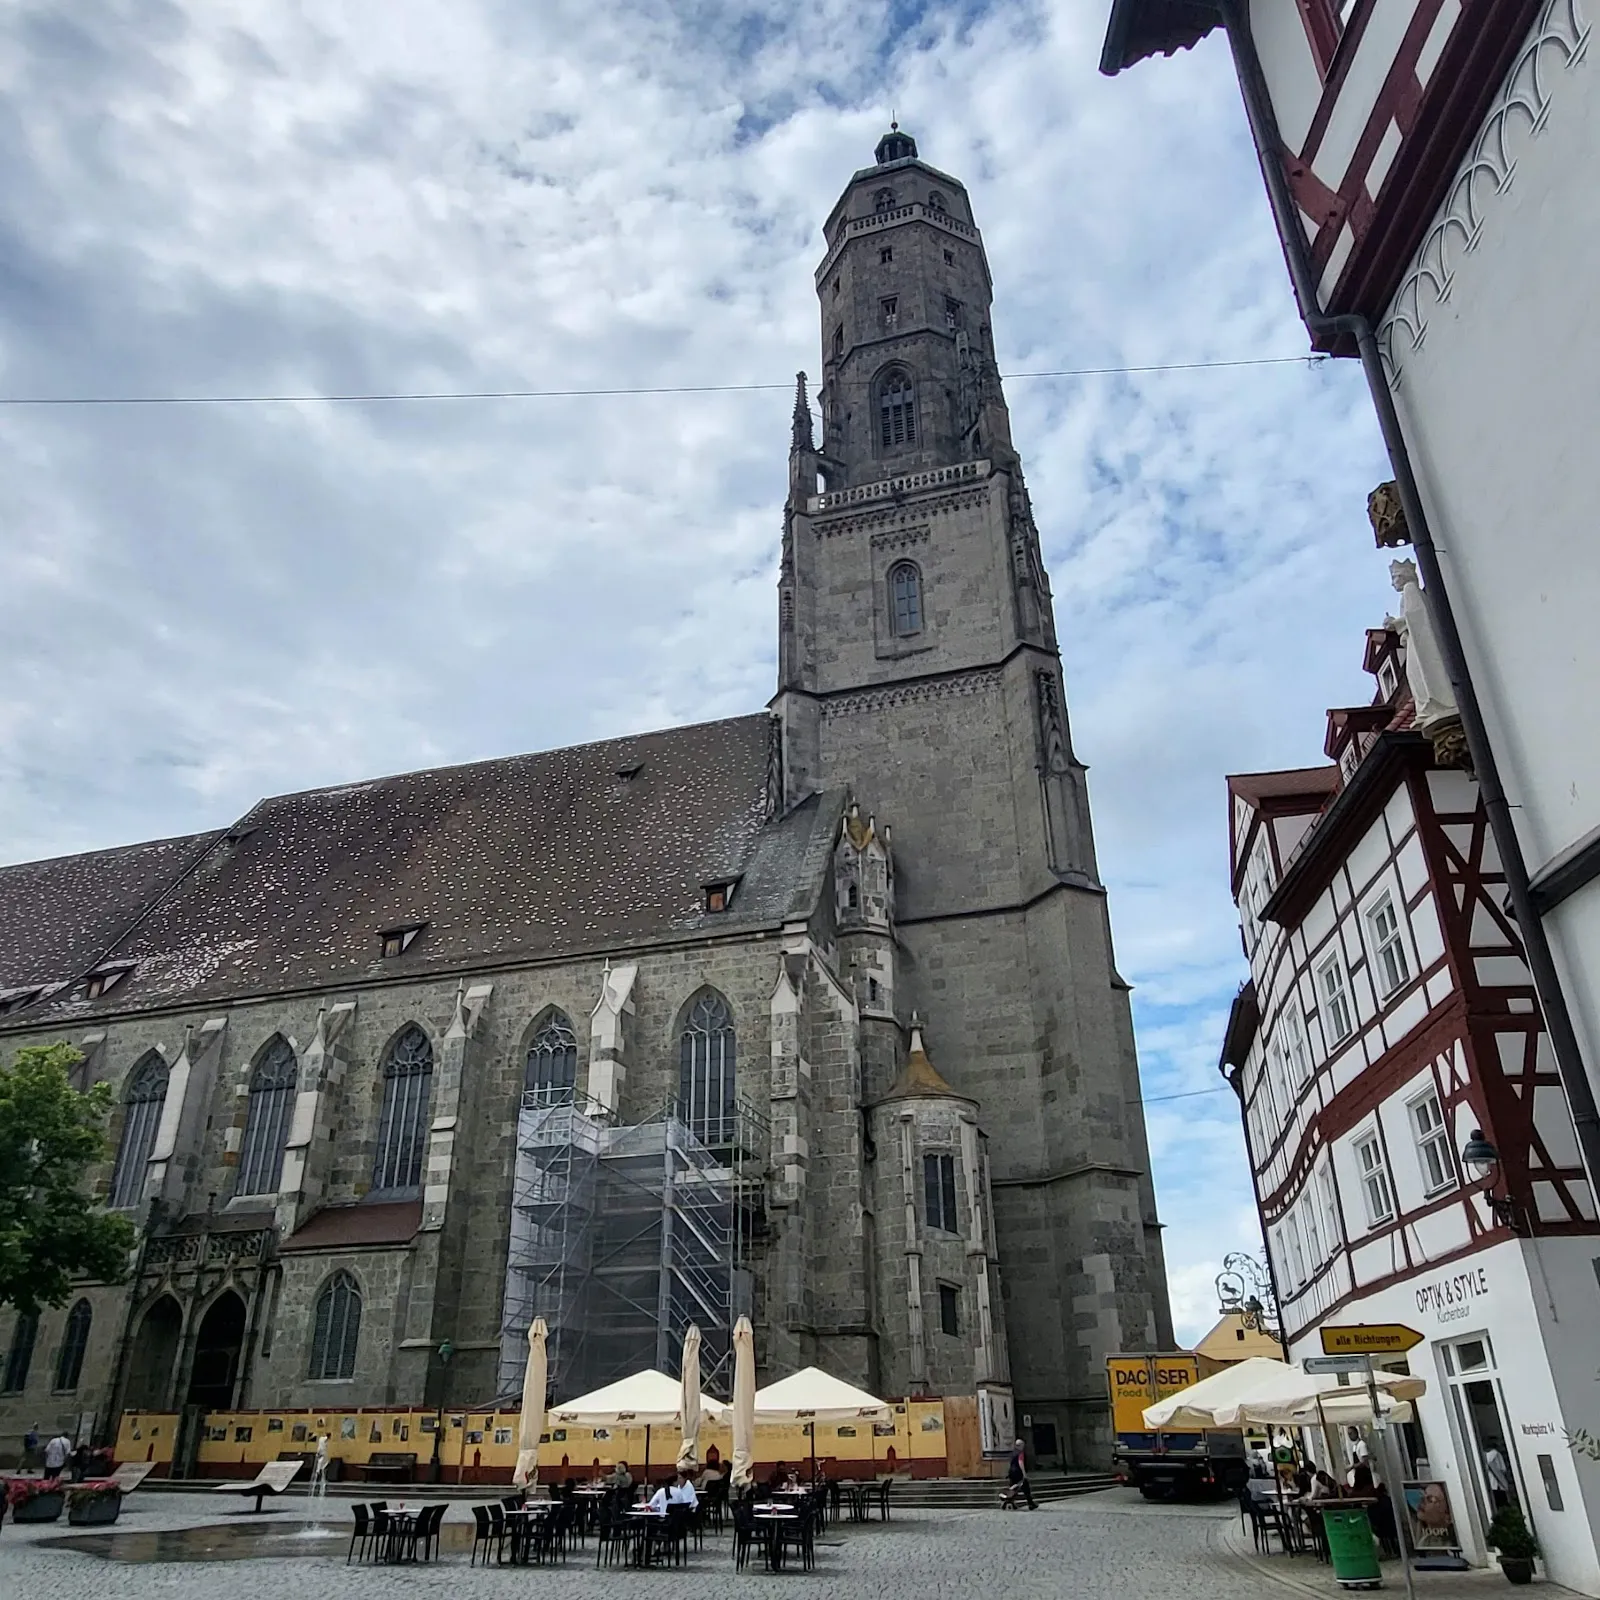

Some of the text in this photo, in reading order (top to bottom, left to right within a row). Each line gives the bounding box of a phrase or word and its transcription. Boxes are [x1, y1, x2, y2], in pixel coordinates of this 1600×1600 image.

[1416, 1268, 1488, 1313] OPTIK & STYLE
[1336, 1334, 1401, 1346] alle Richtungen
[1115, 1369, 1189, 1385] DACHSER
[1117, 1388, 1141, 1398] Food
